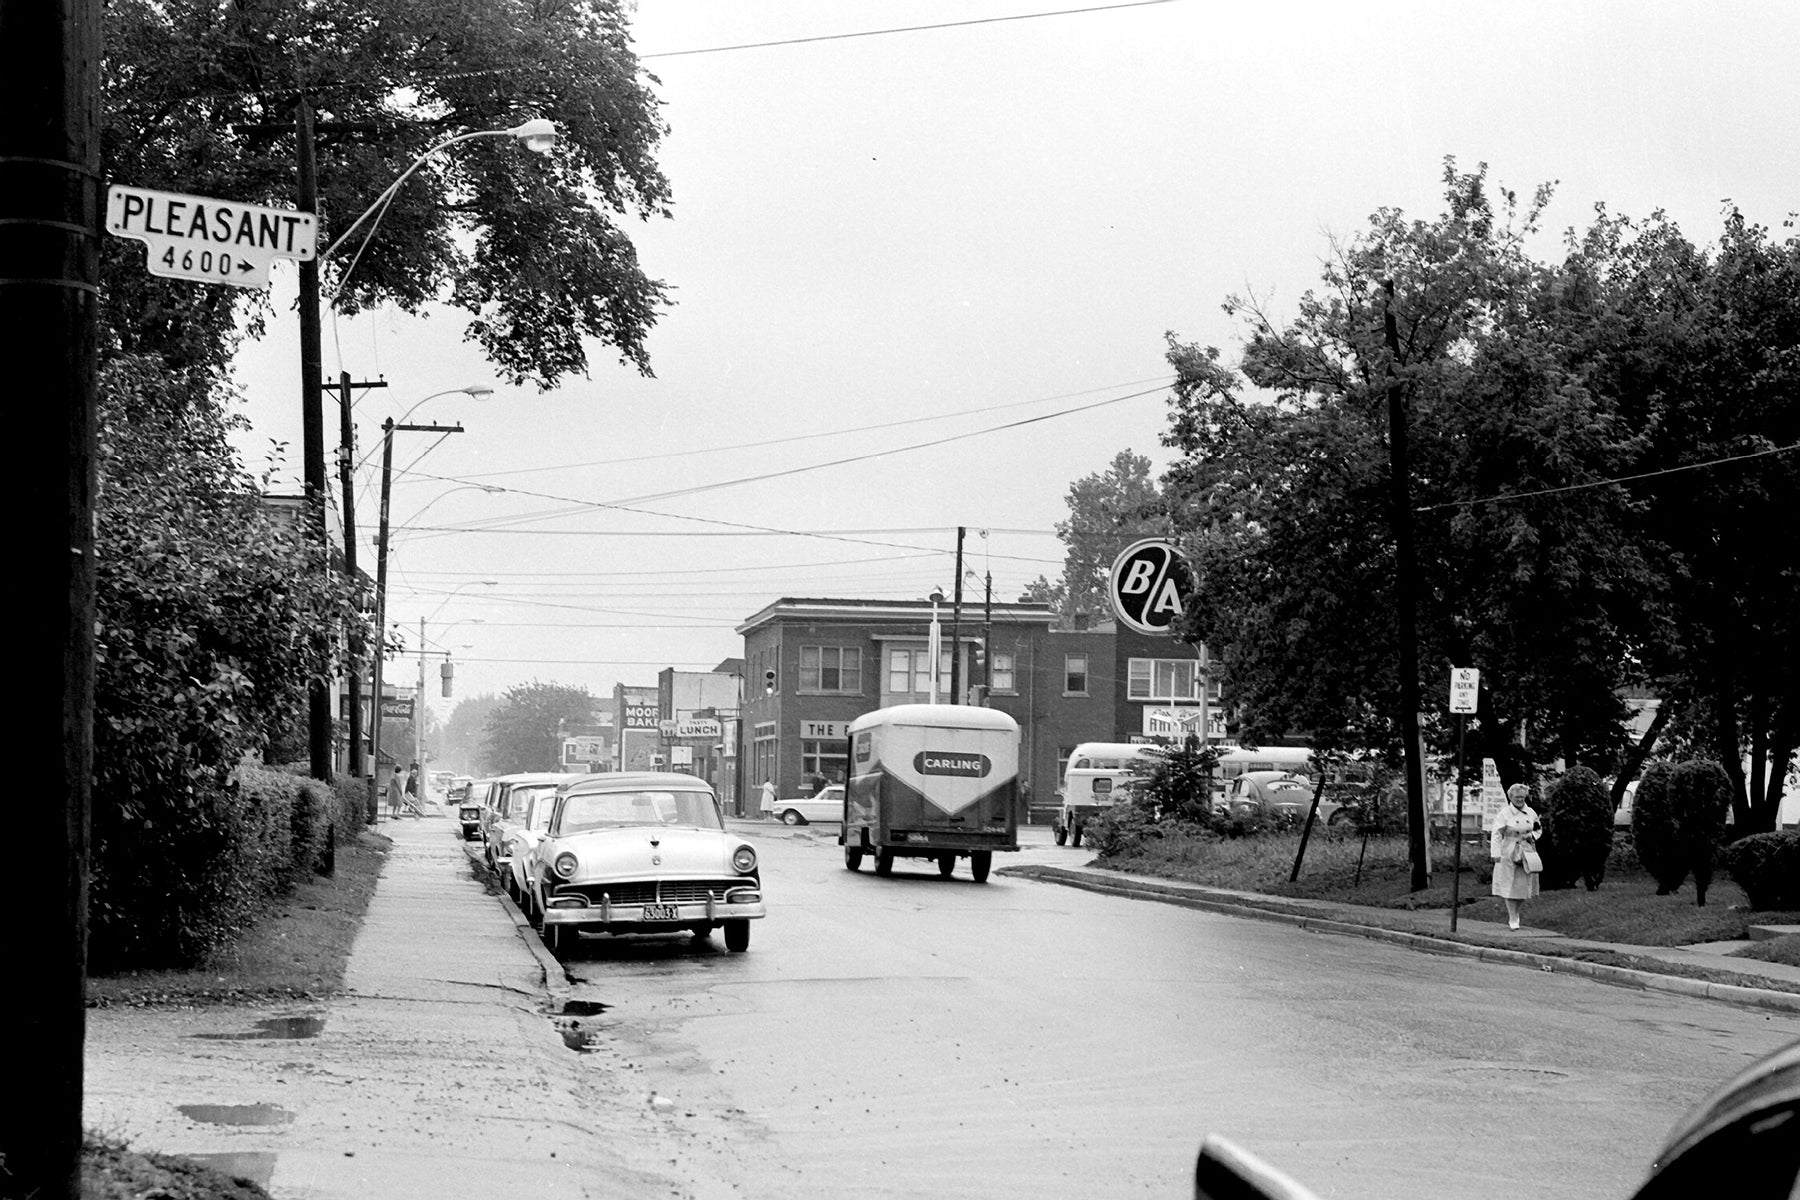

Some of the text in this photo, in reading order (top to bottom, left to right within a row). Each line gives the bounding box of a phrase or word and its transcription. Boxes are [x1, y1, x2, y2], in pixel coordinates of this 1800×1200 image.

[122, 194, 301, 252] PLEASANT
[162, 246, 231, 275] 4600
[1460, 672, 1471, 681] NO
[680, 725, 718, 735] LUNCH
[808, 724, 834, 736] THE
[924, 758, 981, 771] CARLING
